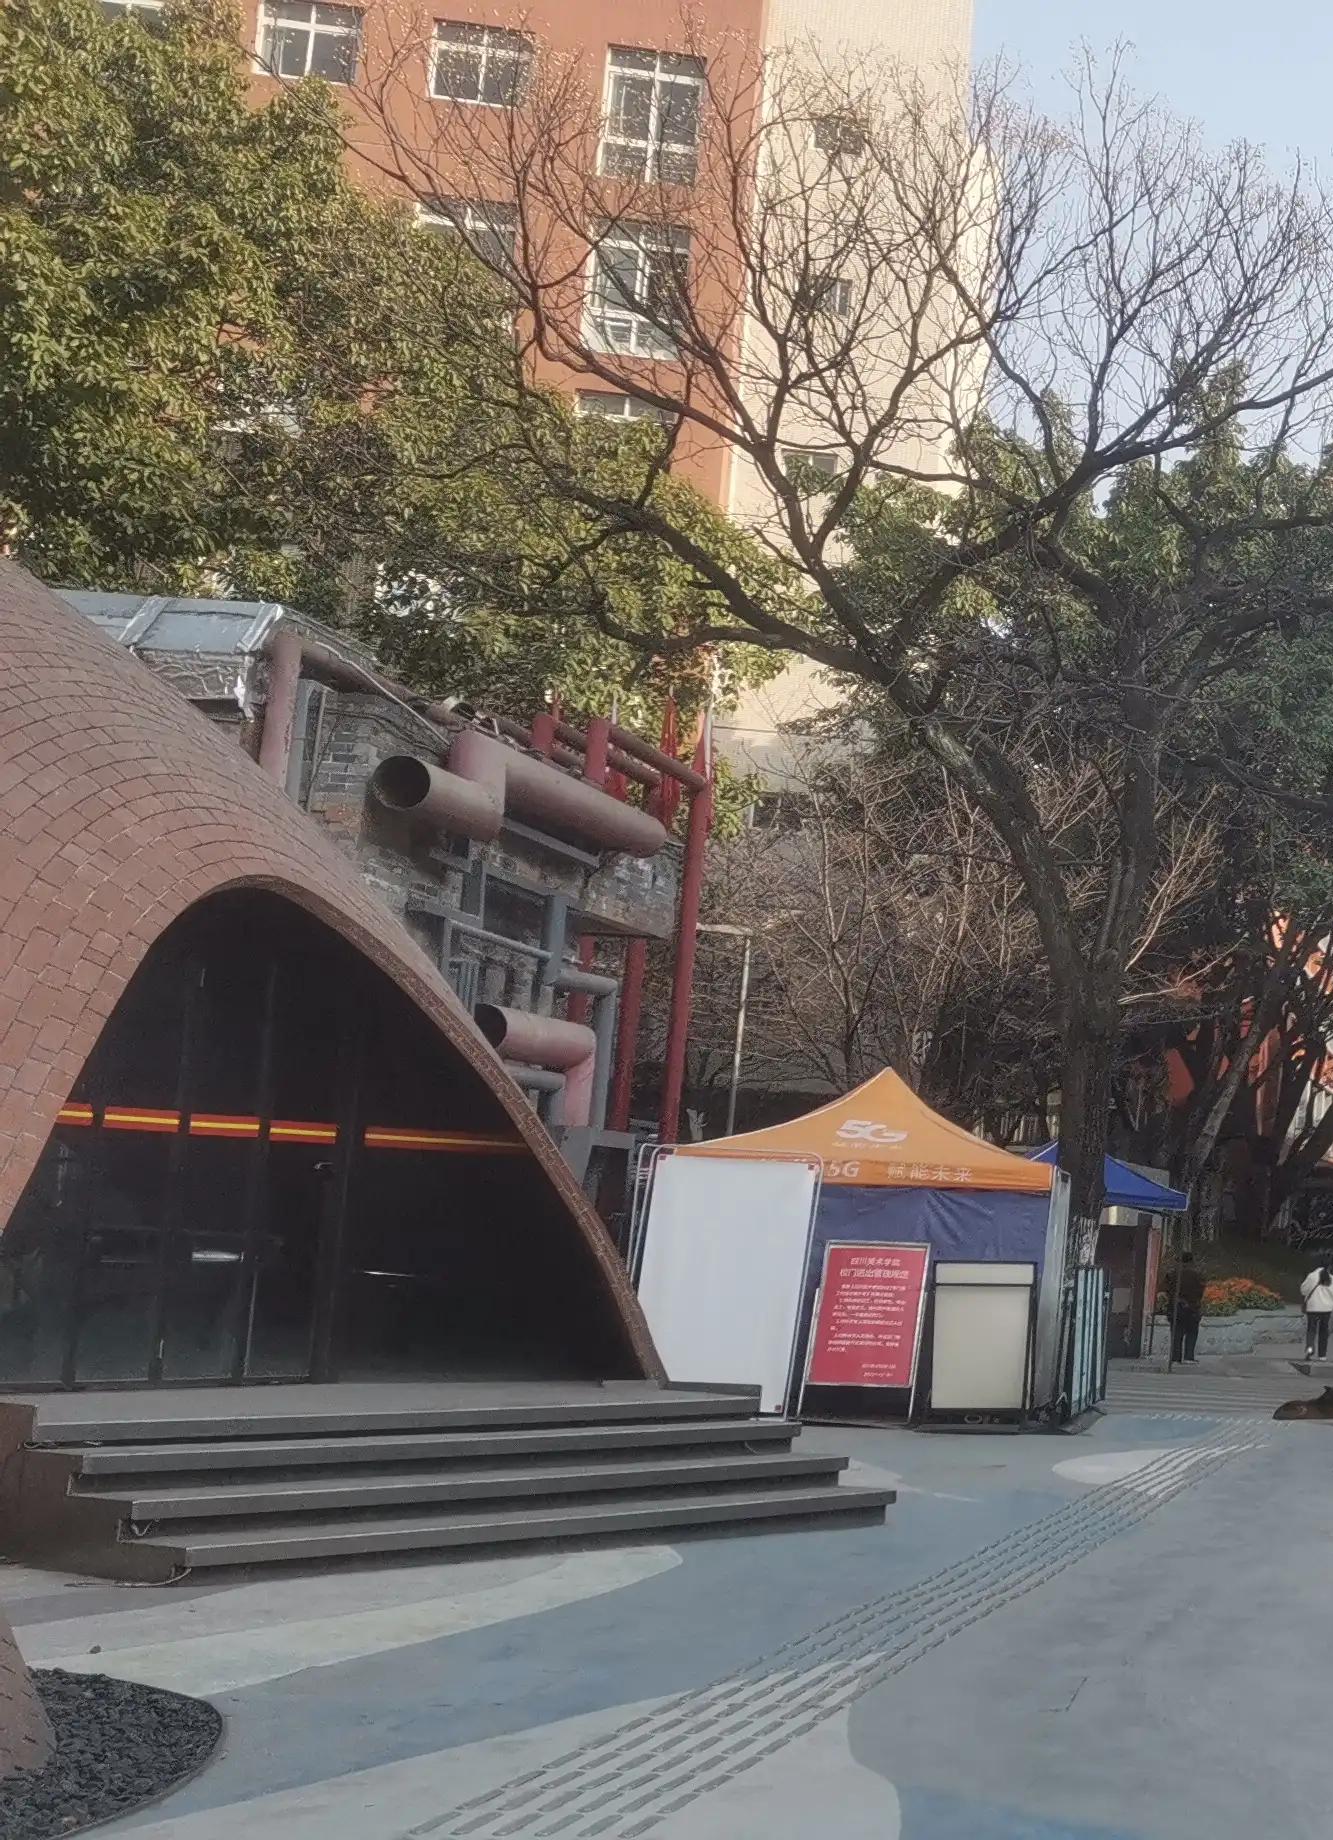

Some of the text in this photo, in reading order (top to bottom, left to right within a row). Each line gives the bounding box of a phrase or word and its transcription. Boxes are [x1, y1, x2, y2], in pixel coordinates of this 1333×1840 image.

[835, 1119, 908, 1143] 5G
[887, 1163, 972, 1182] 赋能未来
